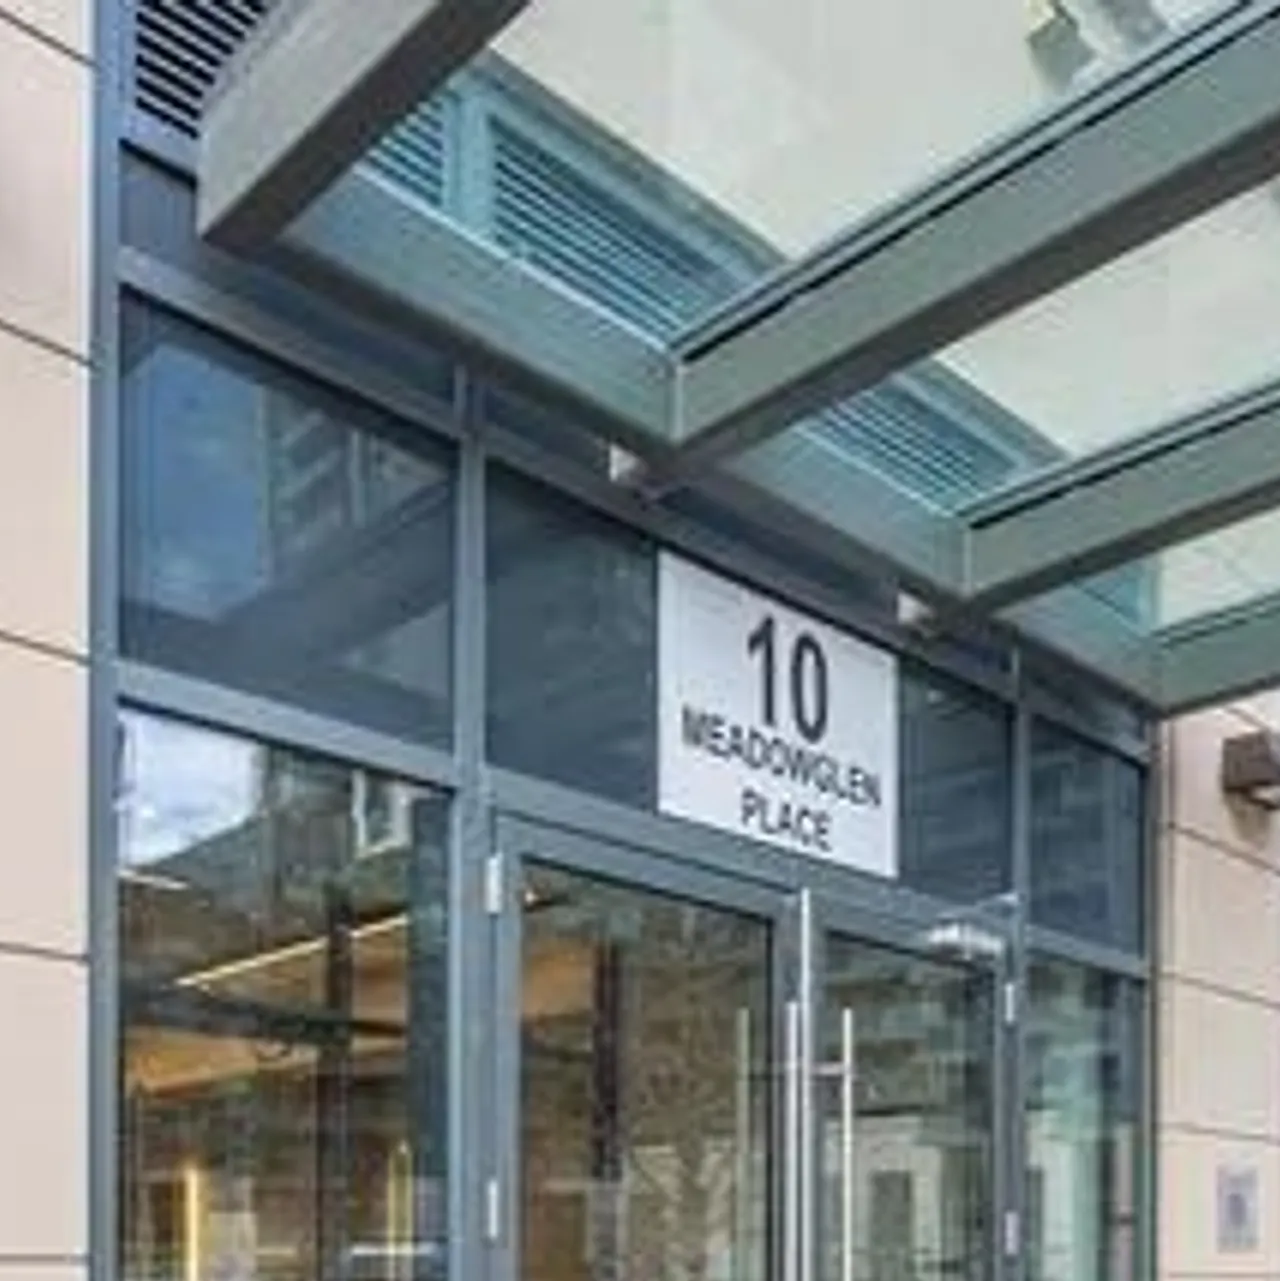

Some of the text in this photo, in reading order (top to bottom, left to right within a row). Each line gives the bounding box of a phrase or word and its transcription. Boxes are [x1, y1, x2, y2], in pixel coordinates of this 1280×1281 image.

[747, 615, 827, 744] 10
[681, 702, 881, 808] MEADOWGLEN
[742, 787, 832, 852] PLACE
